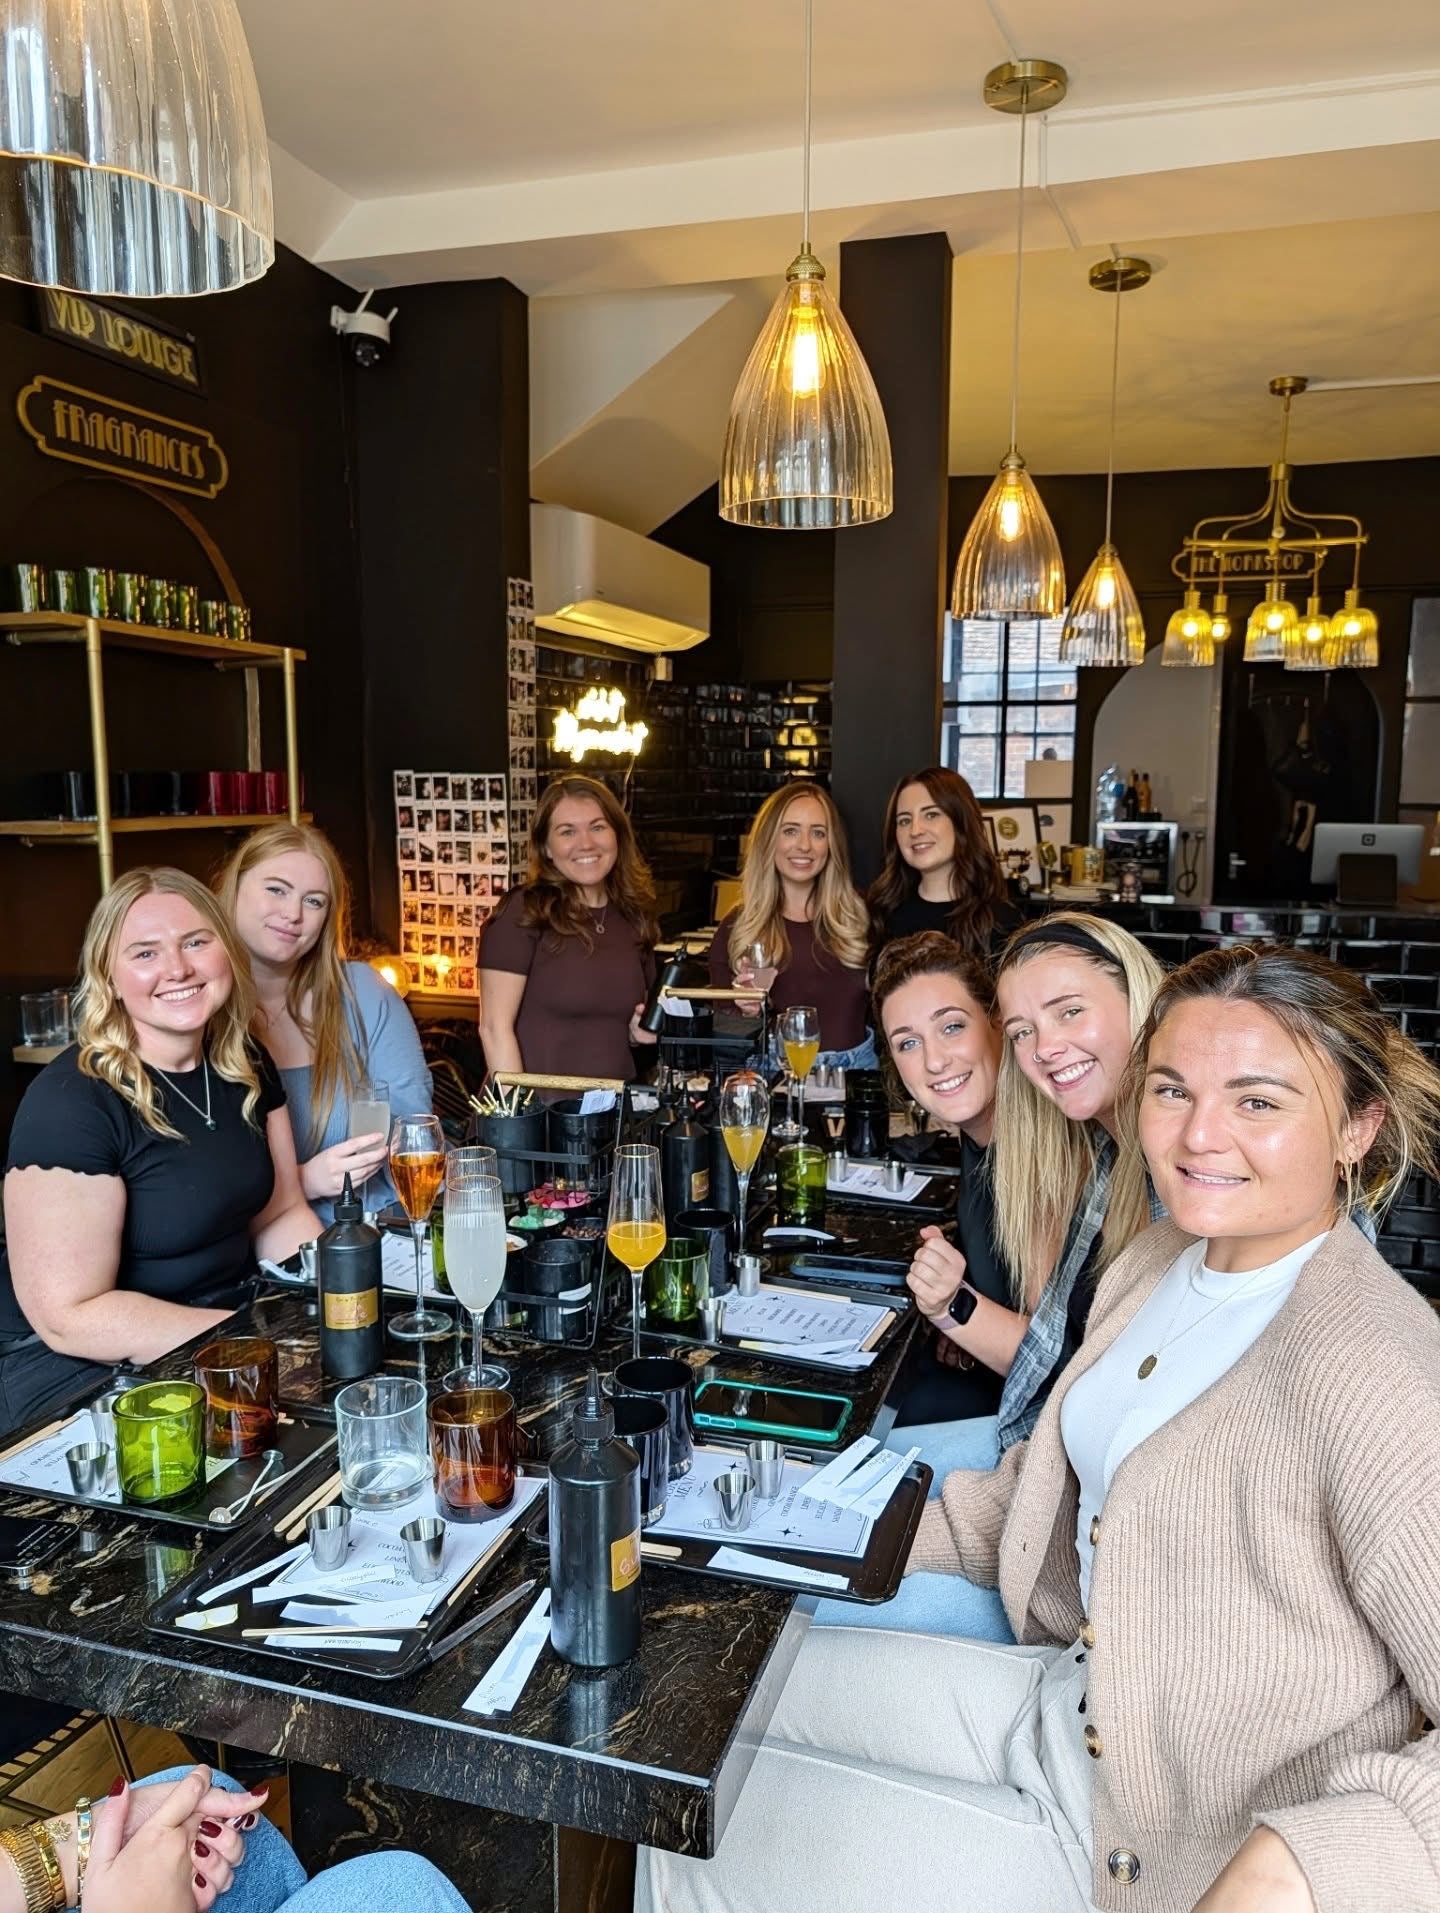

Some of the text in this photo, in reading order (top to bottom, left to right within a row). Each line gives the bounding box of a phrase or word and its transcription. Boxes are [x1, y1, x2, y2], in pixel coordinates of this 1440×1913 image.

[47, 290, 198, 386] VIP LOUNGE
[52, 399, 205, 480] FRAGRANCES
